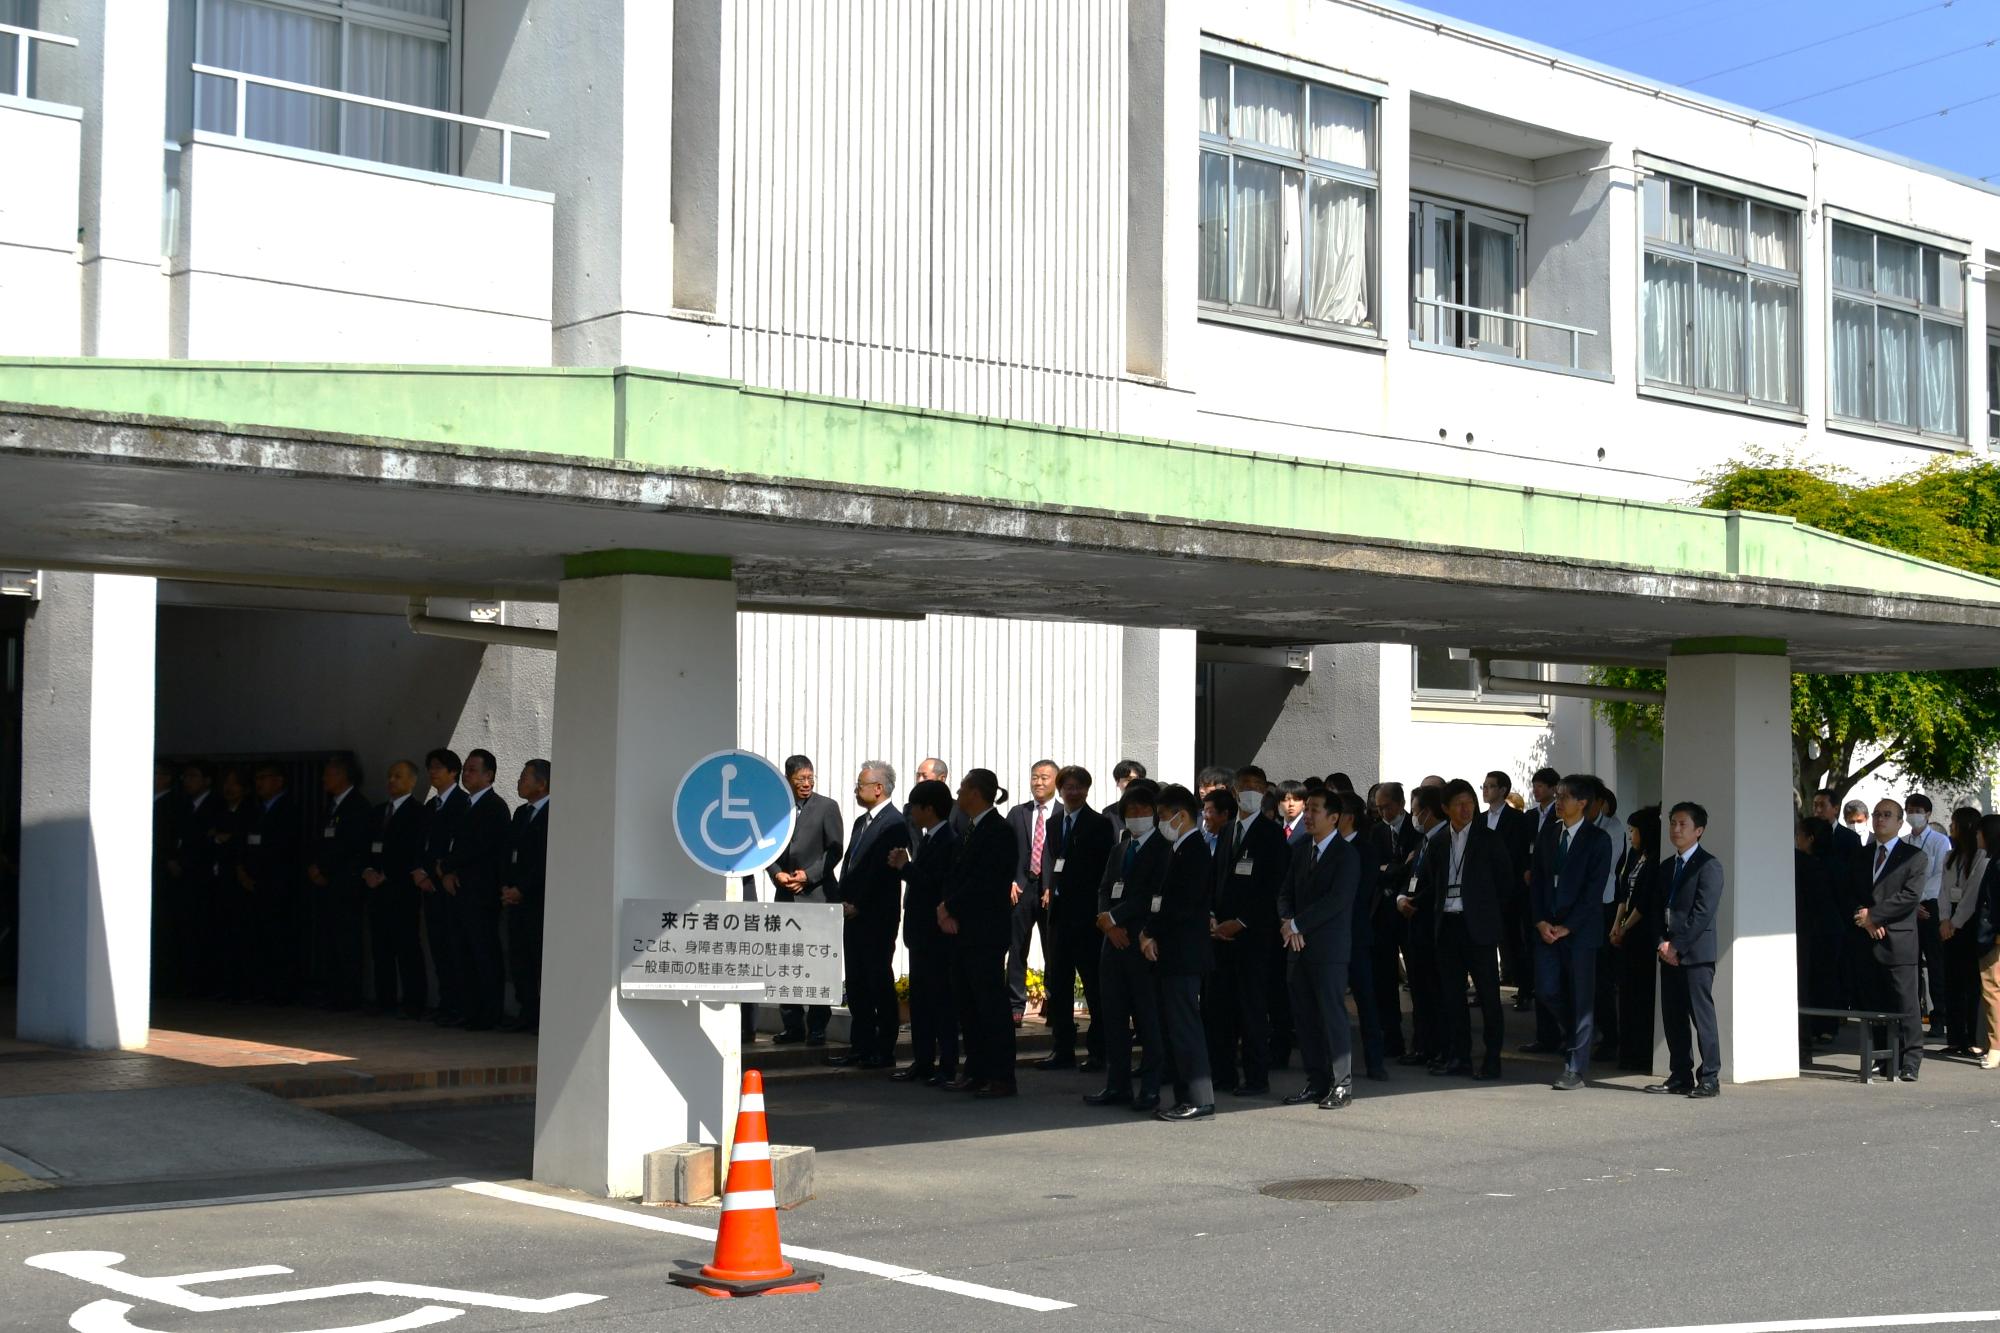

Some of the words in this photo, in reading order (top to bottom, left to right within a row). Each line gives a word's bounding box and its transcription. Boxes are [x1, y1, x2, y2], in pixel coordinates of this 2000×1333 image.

[661, 911, 802, 932] 来庁者の皆様へ
[632, 939, 838, 959] ここは、身障者専用の駐車場です。
[631, 960, 811, 979] 一般車両の駐車を禁止します。
[766, 985, 831, 999] 庁舎管理者
